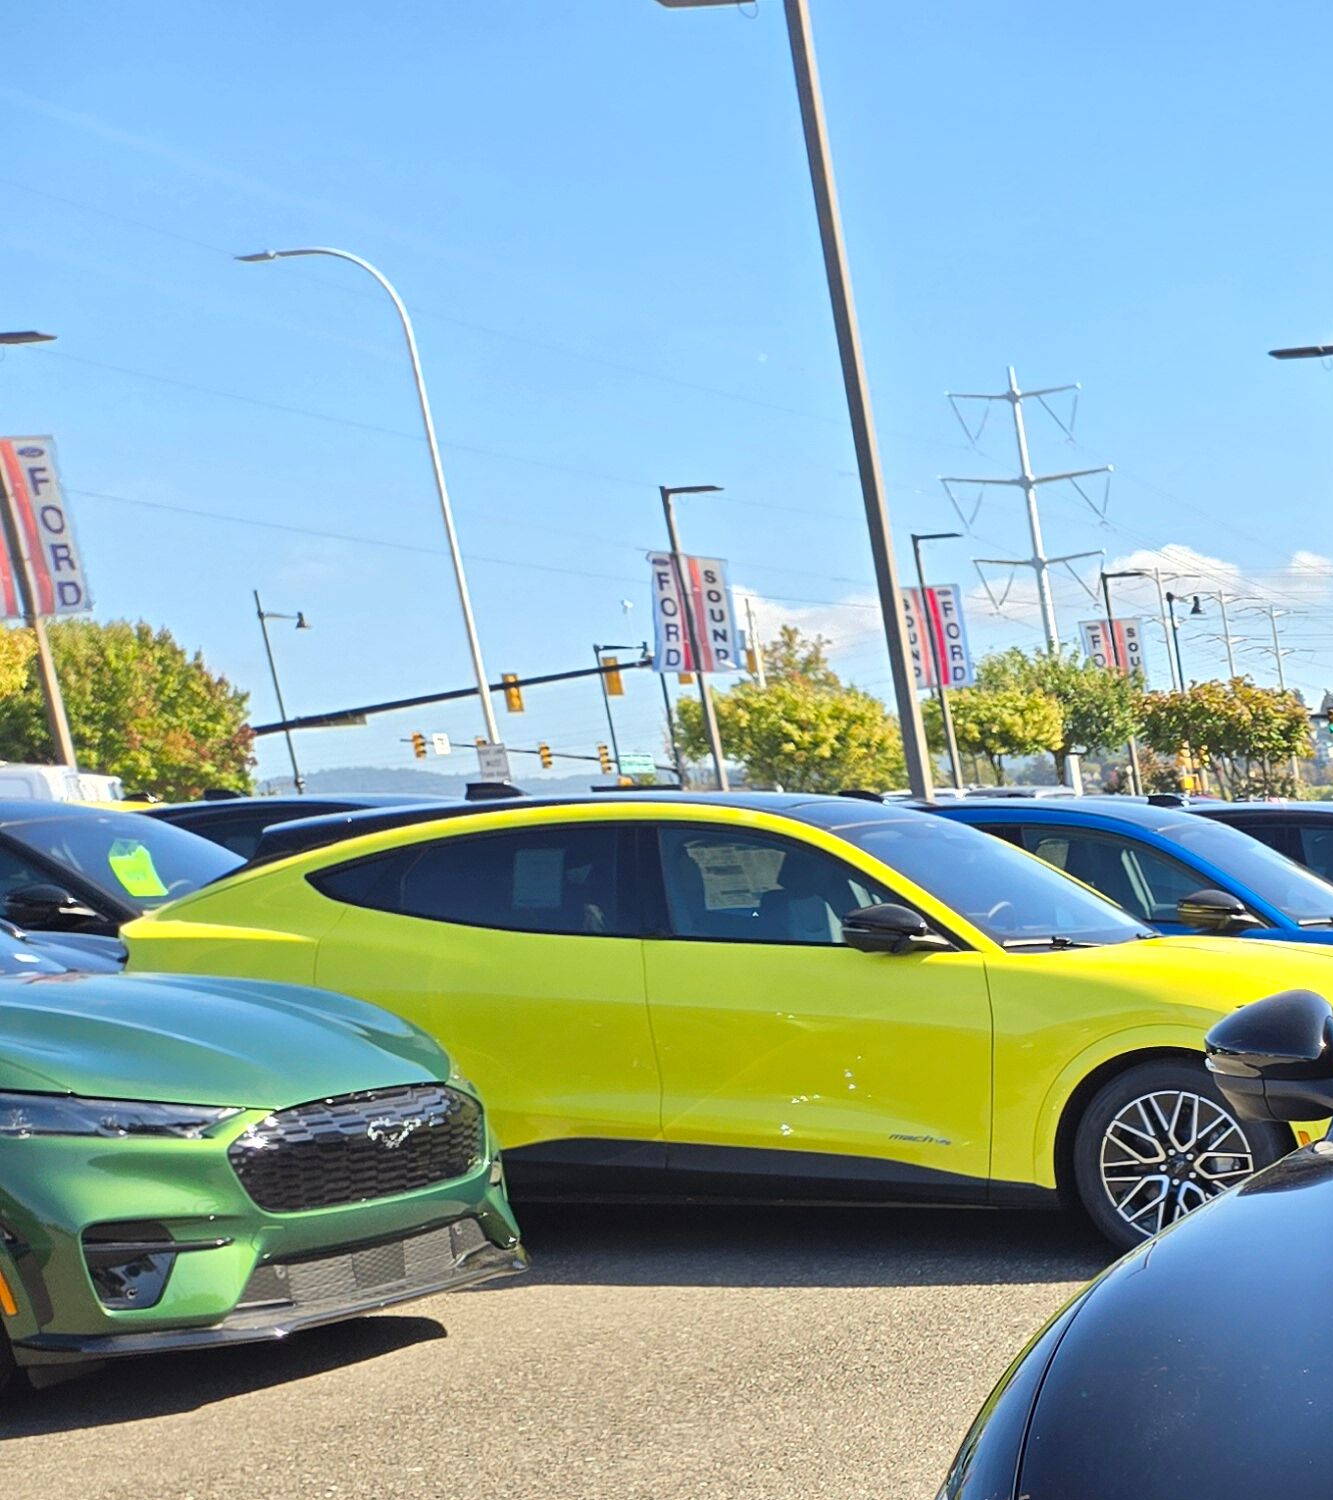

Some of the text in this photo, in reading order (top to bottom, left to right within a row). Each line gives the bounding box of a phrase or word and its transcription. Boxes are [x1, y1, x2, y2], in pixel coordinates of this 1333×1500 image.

[27, 466, 82, 607] FORD
[656, 571, 681, 667] FORD
[703, 569, 730, 661] SOUND
[941, 600, 966, 681] FORD
